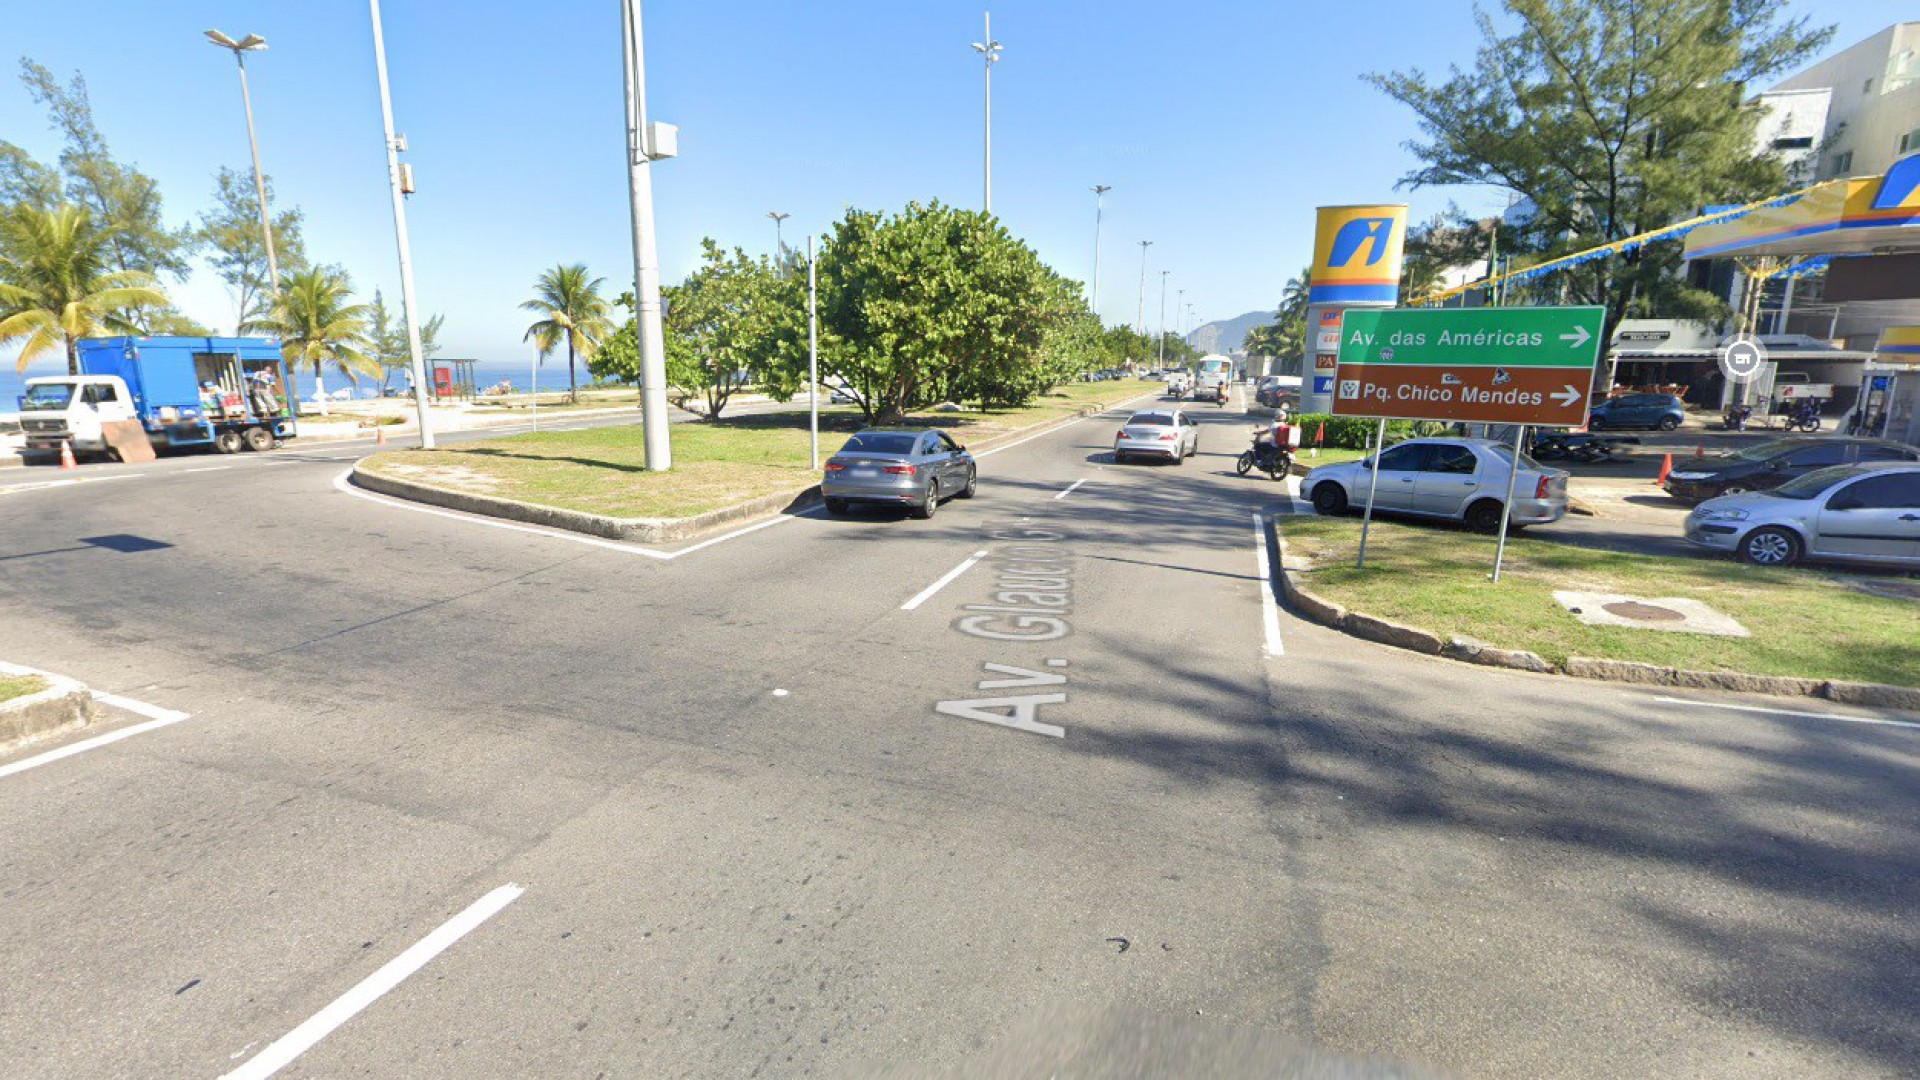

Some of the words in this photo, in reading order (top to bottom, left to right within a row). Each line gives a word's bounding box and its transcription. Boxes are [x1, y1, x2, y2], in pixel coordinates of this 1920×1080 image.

[1349, 329, 1379, 346] Av.
[1389, 330, 1427, 346] das
[1437, 328, 1543, 346] Américas
[1363, 382, 1391, 403] Pq.
[1397, 384, 1453, 401] Chico
[1460, 386, 1542, 405] Mendes
